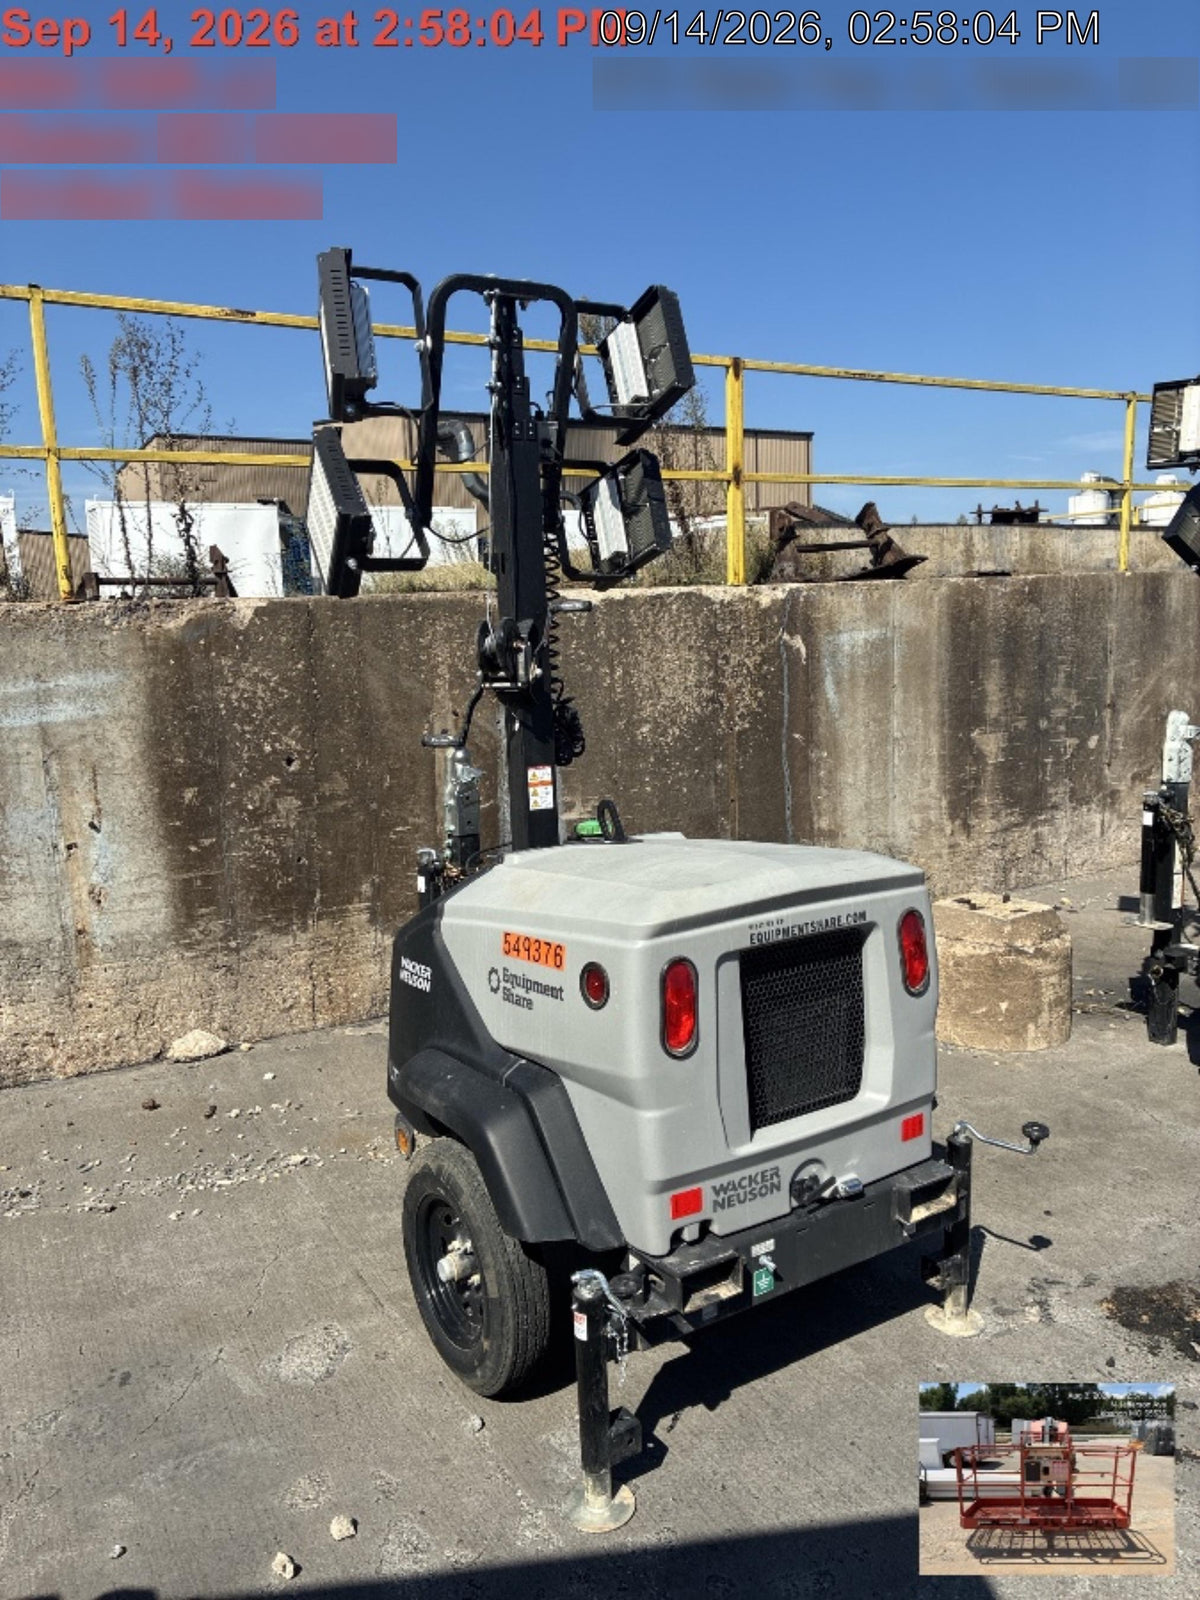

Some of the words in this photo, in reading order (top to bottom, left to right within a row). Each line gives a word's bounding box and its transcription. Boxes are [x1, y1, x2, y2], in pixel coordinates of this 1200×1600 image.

[503, 932, 564, 968] 549376
[502, 967, 565, 1001] Equipment
[502, 986, 534, 1010] Share
[711, 1166, 780, 1198] WACKER
[711, 1180, 782, 1213] NEUSON
